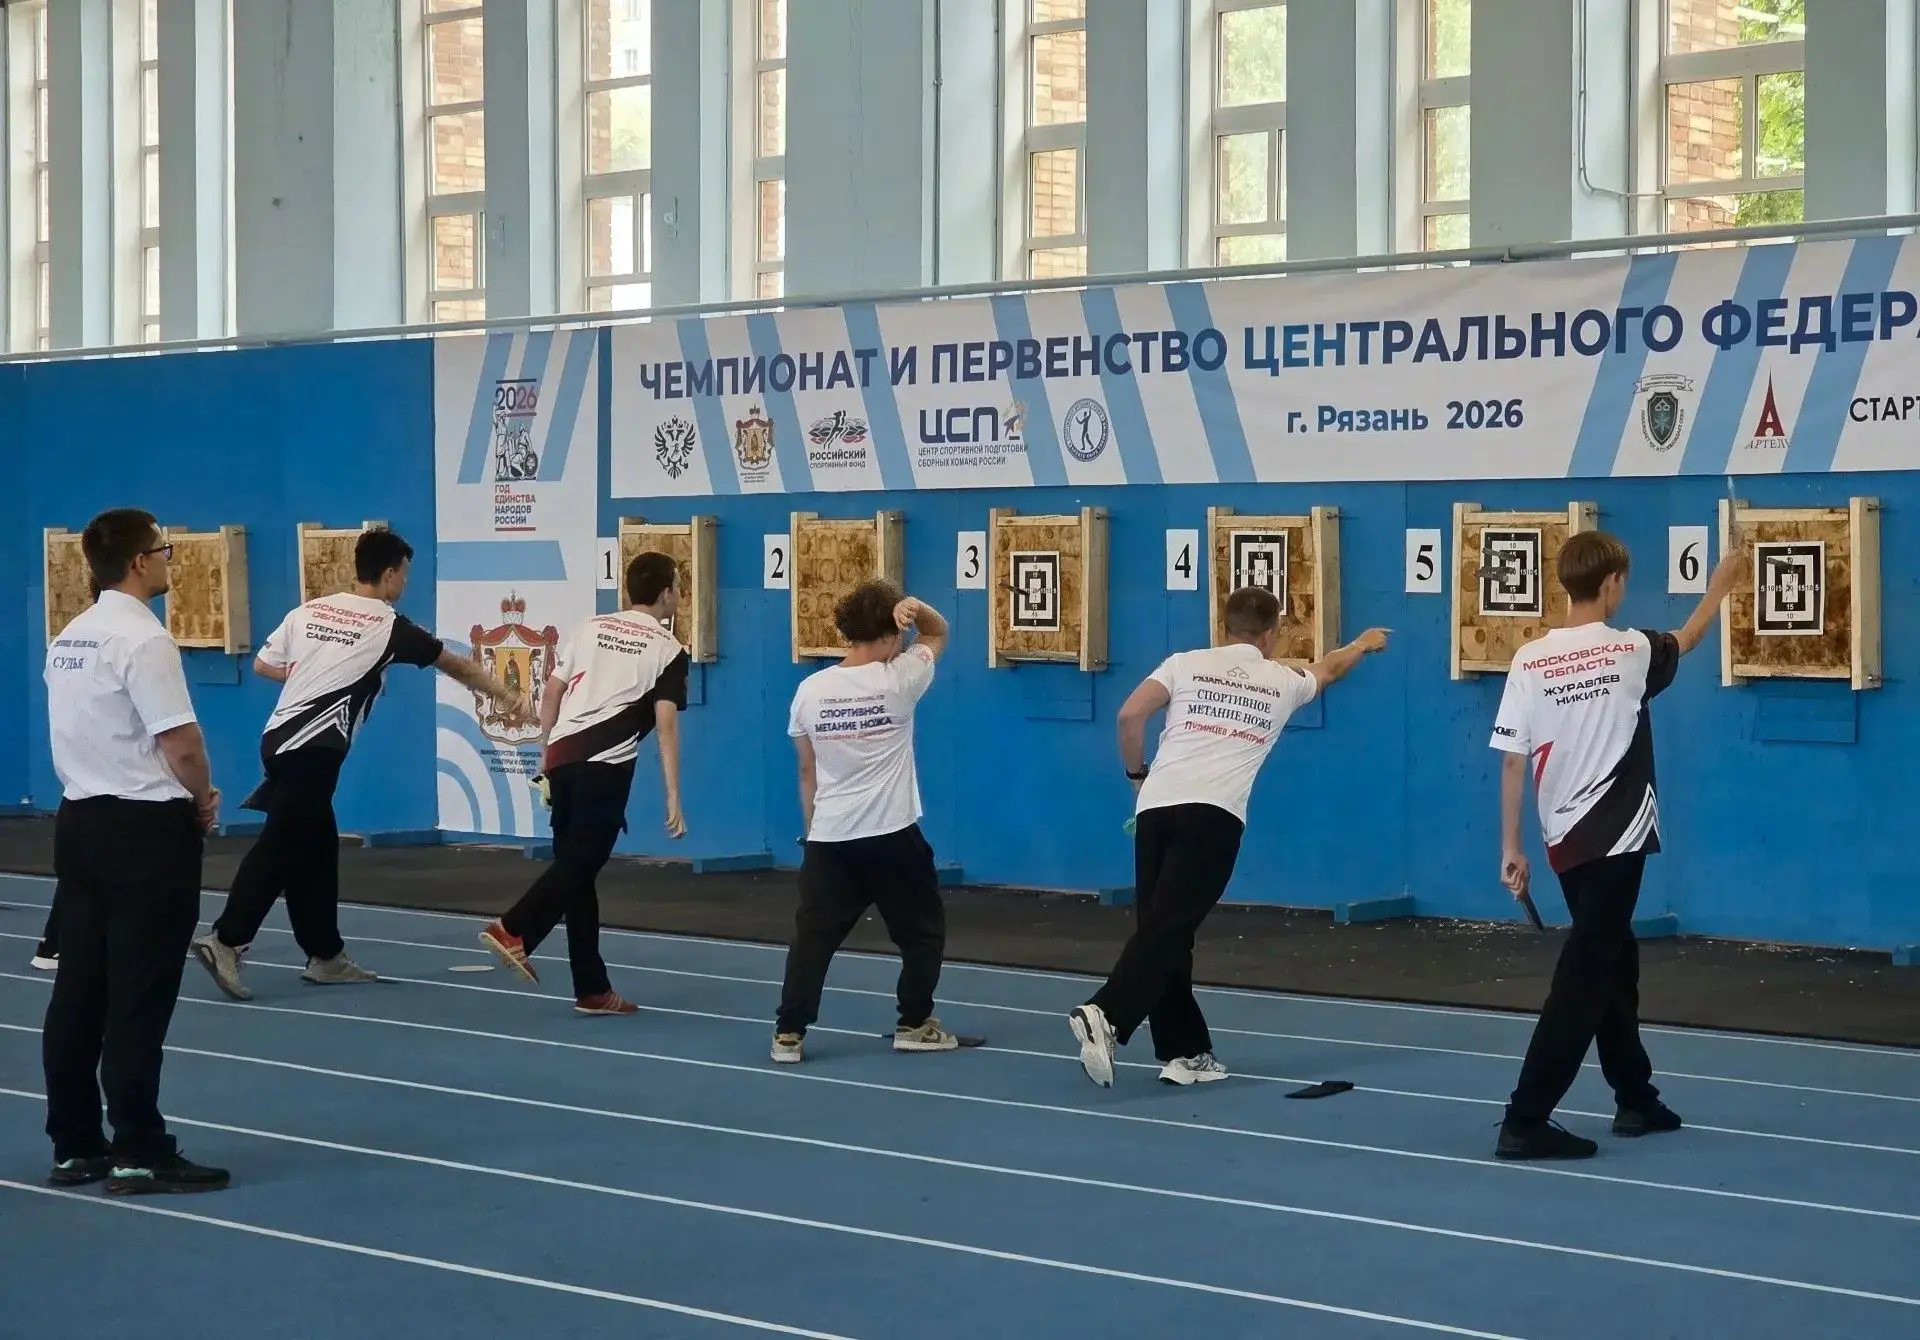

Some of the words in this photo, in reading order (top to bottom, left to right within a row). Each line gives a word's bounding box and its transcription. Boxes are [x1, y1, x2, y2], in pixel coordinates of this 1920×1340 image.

[641, 348, 878, 400] ЧЕМПИОНАТ
[890, 345, 917, 386] И
[931, 328, 1227, 384] ПЕРВЕНСТВО
[1244, 304, 1684, 377] ЦЕНТРАЛЬНОГО
[1701, 291, 1920, 354] ФЕДЕР
[495, 386, 538, 411] 2026
[919, 406, 999, 444] ЦСП
[1287, 411, 1308, 433] г.
[1317, 405, 1429, 433] Рязань
[1446, 398, 1524, 429] 2026
[810, 448, 866, 461] РОССИЙСКИЙ
[918, 447, 939, 456] ЦЕНТР
[939, 444, 983, 455] СПОРТИВНОЙ
[984, 444, 1028, 454] ПОДГОТОВКИ
[810, 461, 848, 469] СПОРТИВНЫЙ
[848, 461, 866, 469] ФОНД
[918, 458, 950, 467] СБОРНЫХ
[950, 457, 978, 467] КОМАНД
[978, 456, 1006, 466] РОССИИ
[494, 484, 510, 494] ГОД
[494, 494, 536, 504] ЕДИНСТВА
[494, 505, 532, 515] НАРОДОВ
[494, 515, 527, 525] РОССИИ
[602, 549, 614, 580] 1
[770, 547, 785, 579] 2
[964, 545, 980, 579] 3
[1174, 543, 1191, 578] 4
[1416, 544, 1434, 581] 5
[1679, 541, 1700, 581] 6
[312, 611, 365, 628] ОБЛАСТЬ
[306, 623, 362, 640] СТЕПАНОВ
[597, 633, 648, 648] ЕВЛАНОВ
[599, 623, 654, 640] ОБЛАСТЬ
[53, 656, 84, 670] СУДЬЯ
[1523, 643, 1635, 672] МОСКОВСКАЯ
[1543, 658, 1616, 680] ОБЛАСТЬ
[1543, 674, 1620, 697] ЖУРАВЛЕВ
[1197, 689, 1272, 714] СПОРТИВНОЕ
[1556, 687, 1611, 706] НИКИТА
[820, 705, 886, 719] СПОРТИВНОЕ
[1187, 704, 1242, 721] МЕТАНИЕ
[1243, 712, 1272, 731] НОЖА
[814, 721, 857, 733] МЕТАНИЕ
[860, 716, 894, 730] НОЖА
